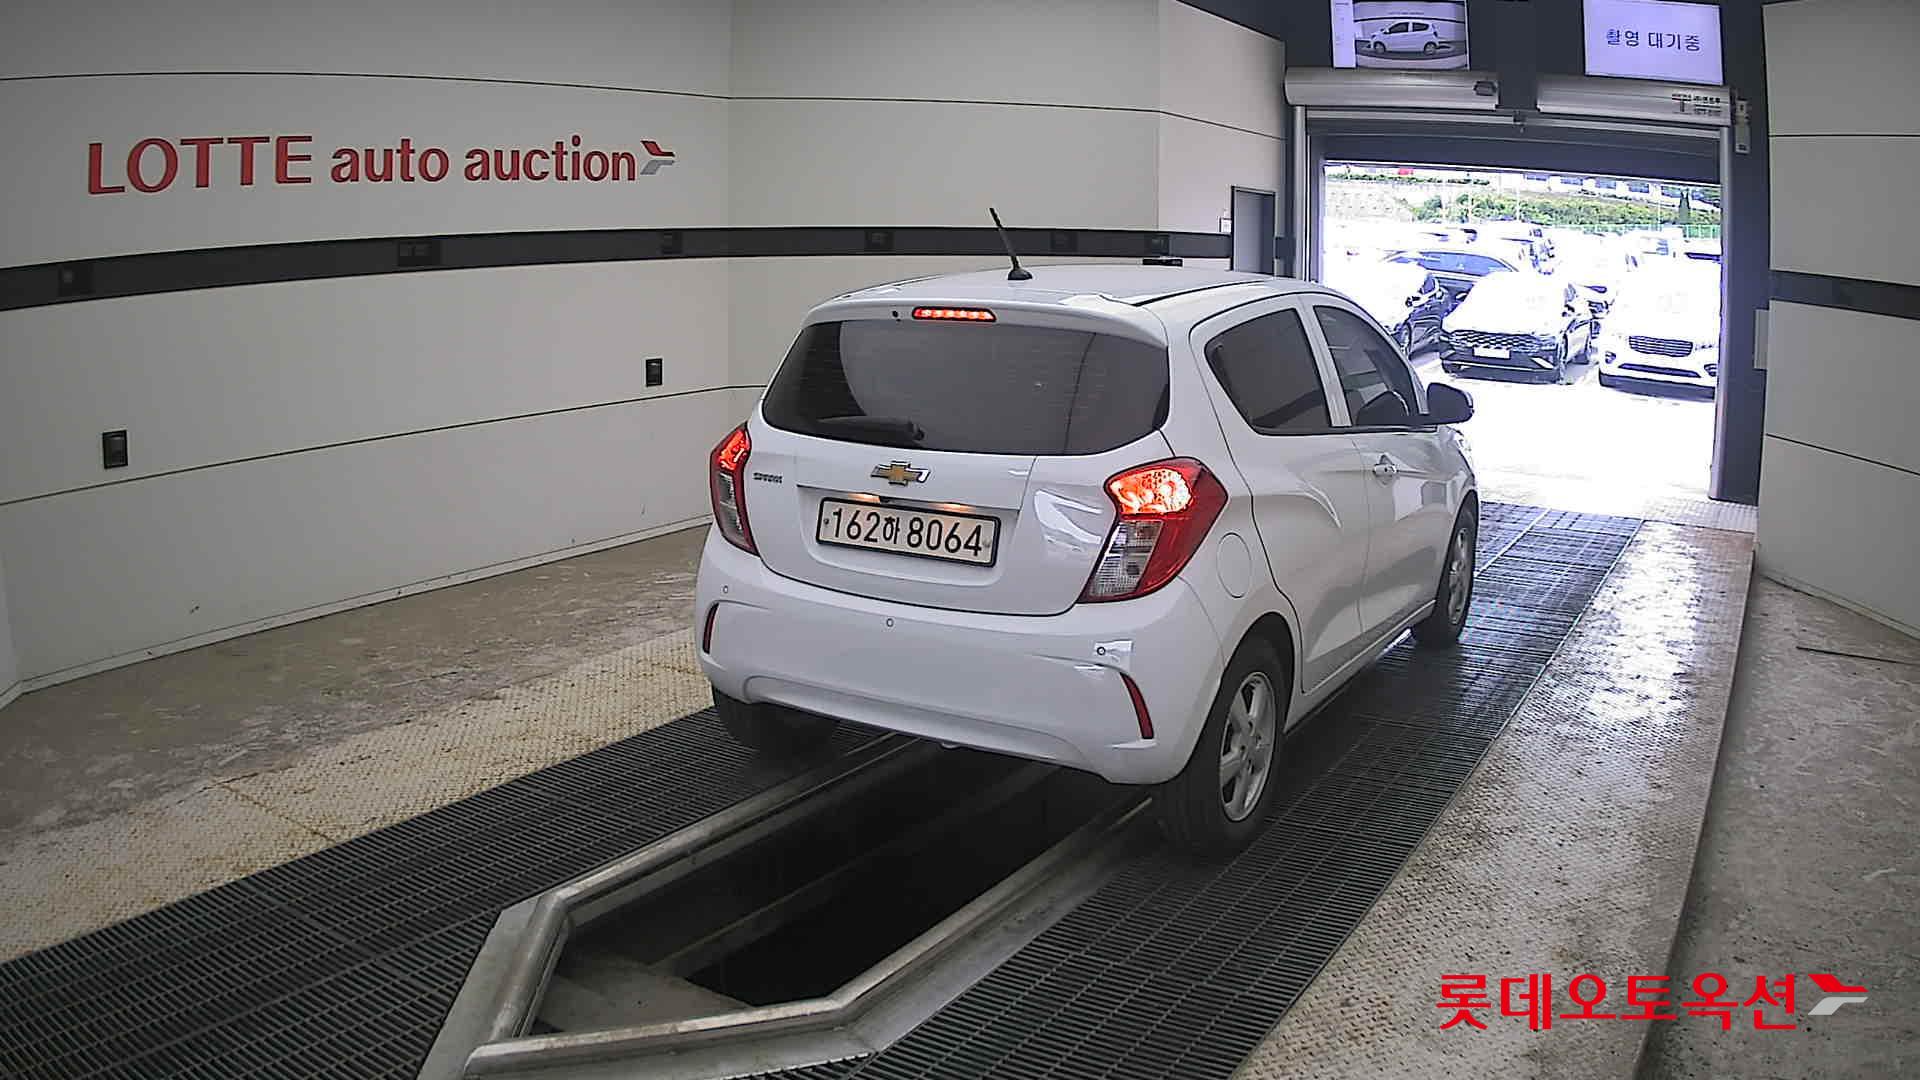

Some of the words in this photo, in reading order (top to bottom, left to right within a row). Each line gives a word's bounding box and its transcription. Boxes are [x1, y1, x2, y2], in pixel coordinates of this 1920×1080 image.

[1648, 32, 1700, 52] 대기중
[88, 135, 312, 194] LOTTE
[331, 138, 449, 183] auto
[463, 135, 637, 183] auction
[833, 508, 900, 545] 162하
[907, 516, 983, 557] 8064
